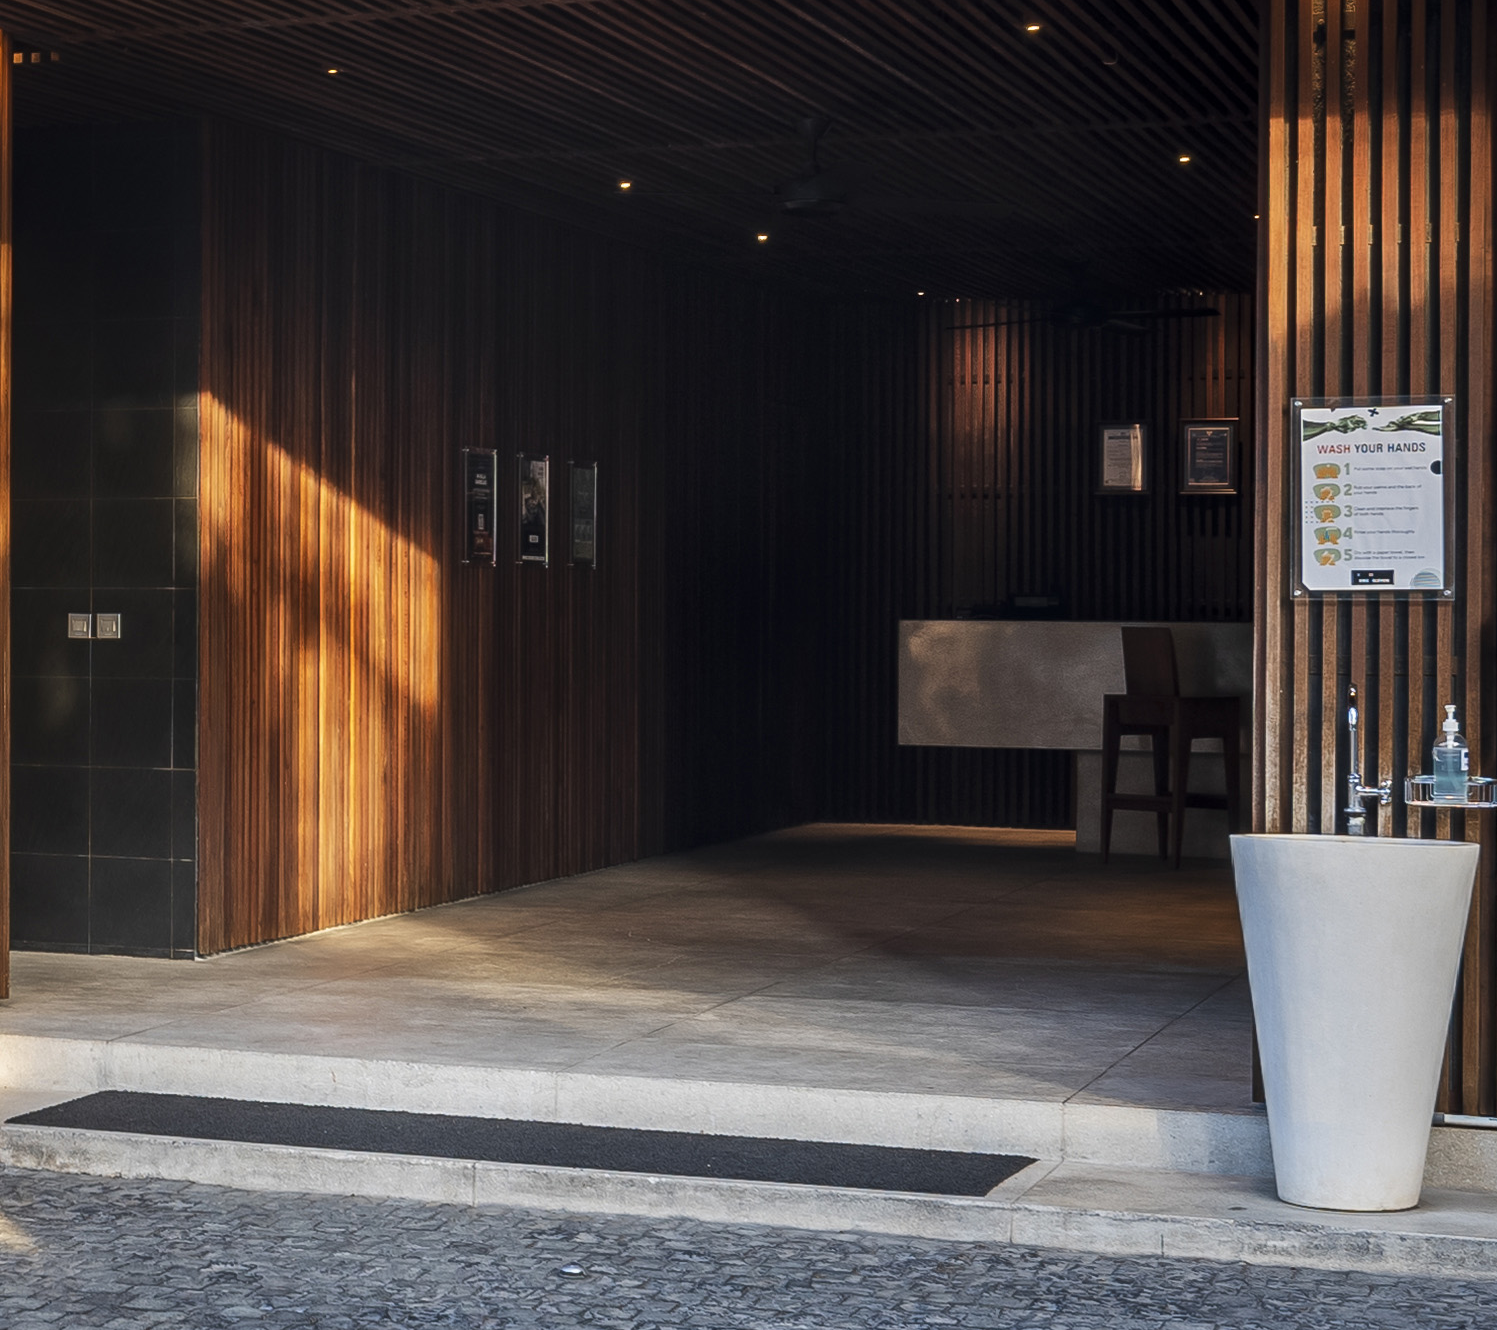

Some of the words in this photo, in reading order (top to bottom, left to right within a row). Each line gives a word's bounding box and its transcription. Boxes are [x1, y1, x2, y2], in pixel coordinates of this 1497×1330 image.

[1317, 445, 1350, 454] WASH
[1354, 443, 1383, 453] YOUR
[1388, 442, 1426, 453] HANDS
[1344, 463, 1350, 475] 1
[1344, 483, 1352, 496] 2
[1344, 505, 1352, 517] 3
[1343, 527, 1353, 539] 4
[1344, 549, 1352, 561] 5
